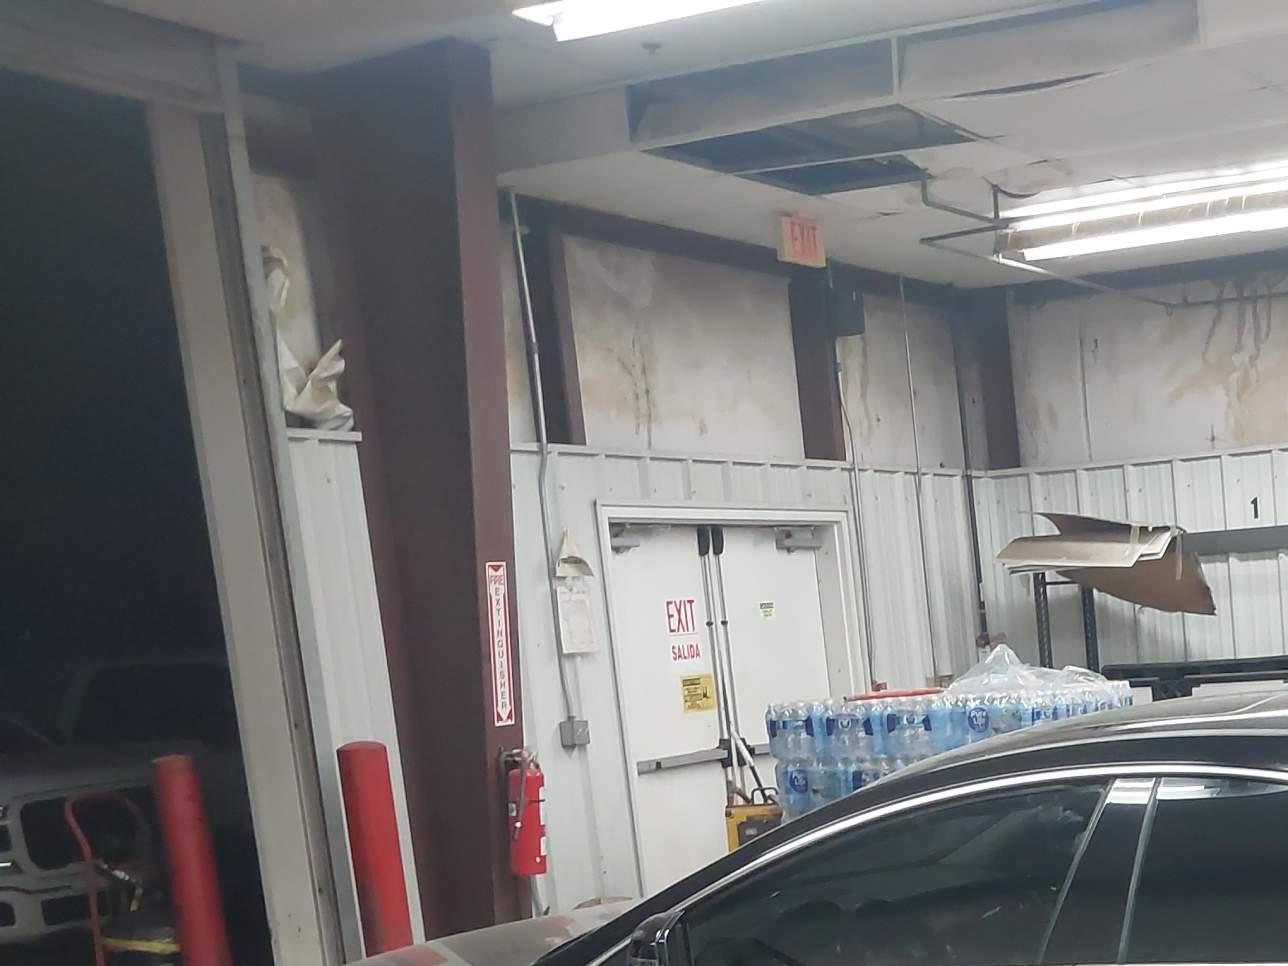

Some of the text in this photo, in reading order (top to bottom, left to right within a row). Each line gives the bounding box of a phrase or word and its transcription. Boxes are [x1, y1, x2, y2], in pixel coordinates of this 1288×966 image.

[789, 220, 818, 257] EXIT
[1250, 496, 1259, 519] 1
[666, 599, 696, 633] EXIT
[494, 587, 507, 710] EXTINGUISHER
[671, 643, 701, 661] SALIDA
